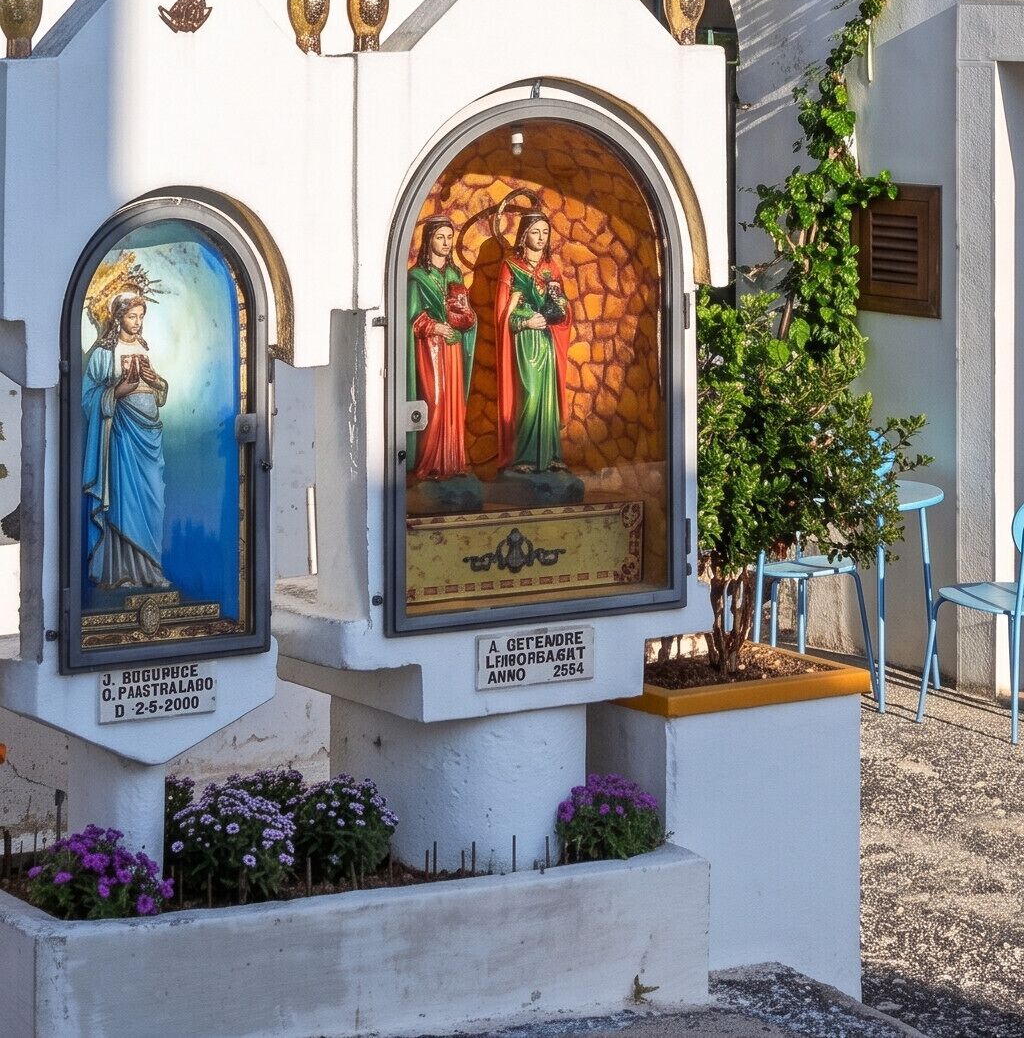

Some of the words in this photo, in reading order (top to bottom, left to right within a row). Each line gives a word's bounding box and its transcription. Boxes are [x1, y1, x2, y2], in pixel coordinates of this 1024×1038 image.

[487, 667, 526, 685] ANNO
[552, 661, 585, 678] 2554
[114, 704, 125, 719] D
